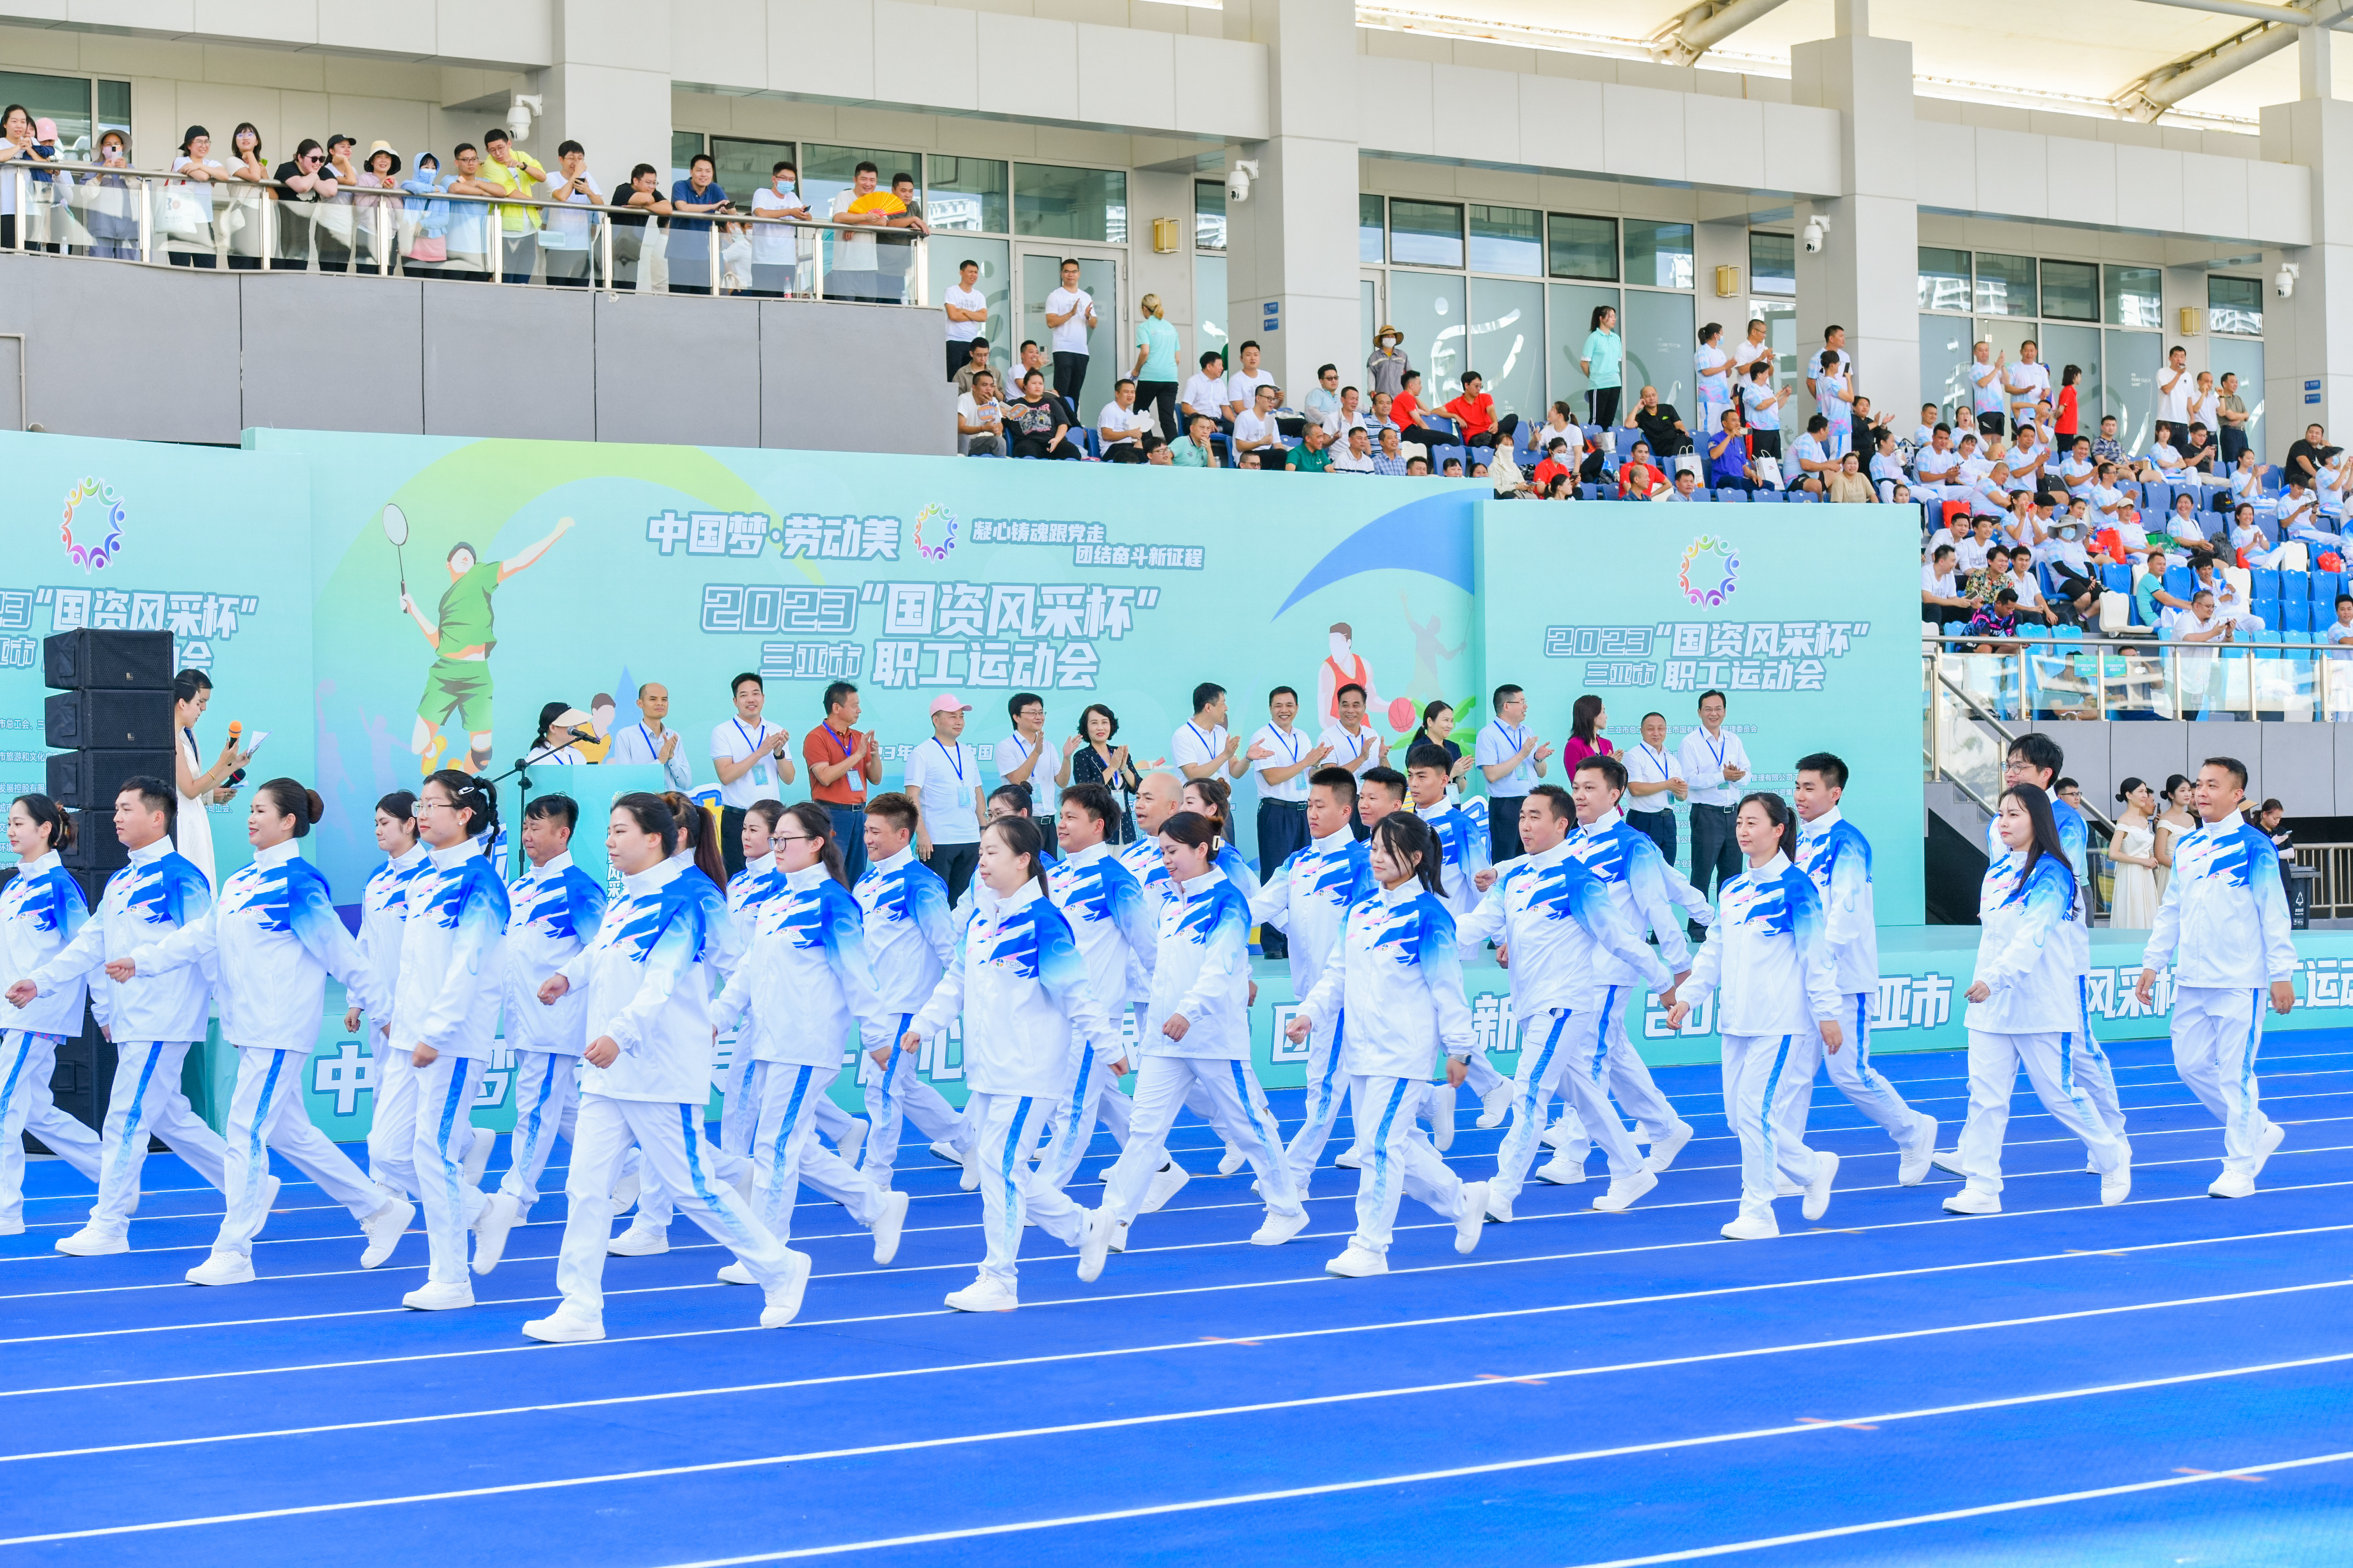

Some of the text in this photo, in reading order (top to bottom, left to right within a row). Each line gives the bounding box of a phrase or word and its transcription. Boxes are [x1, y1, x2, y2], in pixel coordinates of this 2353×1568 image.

[648, 510, 901, 560] 中国梦·劳动美
[972, 519, 1106, 545] 凝心铸魂跟党走
[1074, 544, 1204, 569] 团结奋斗新征程
[758, 639, 1100, 689] 三亚市 职工运动会
[1583, 659, 1826, 691] 三亚市 职工运动会
[0, 750, 51, 762] 市旅游和文化
[0, 782, 46, 793] 发展控股有限
